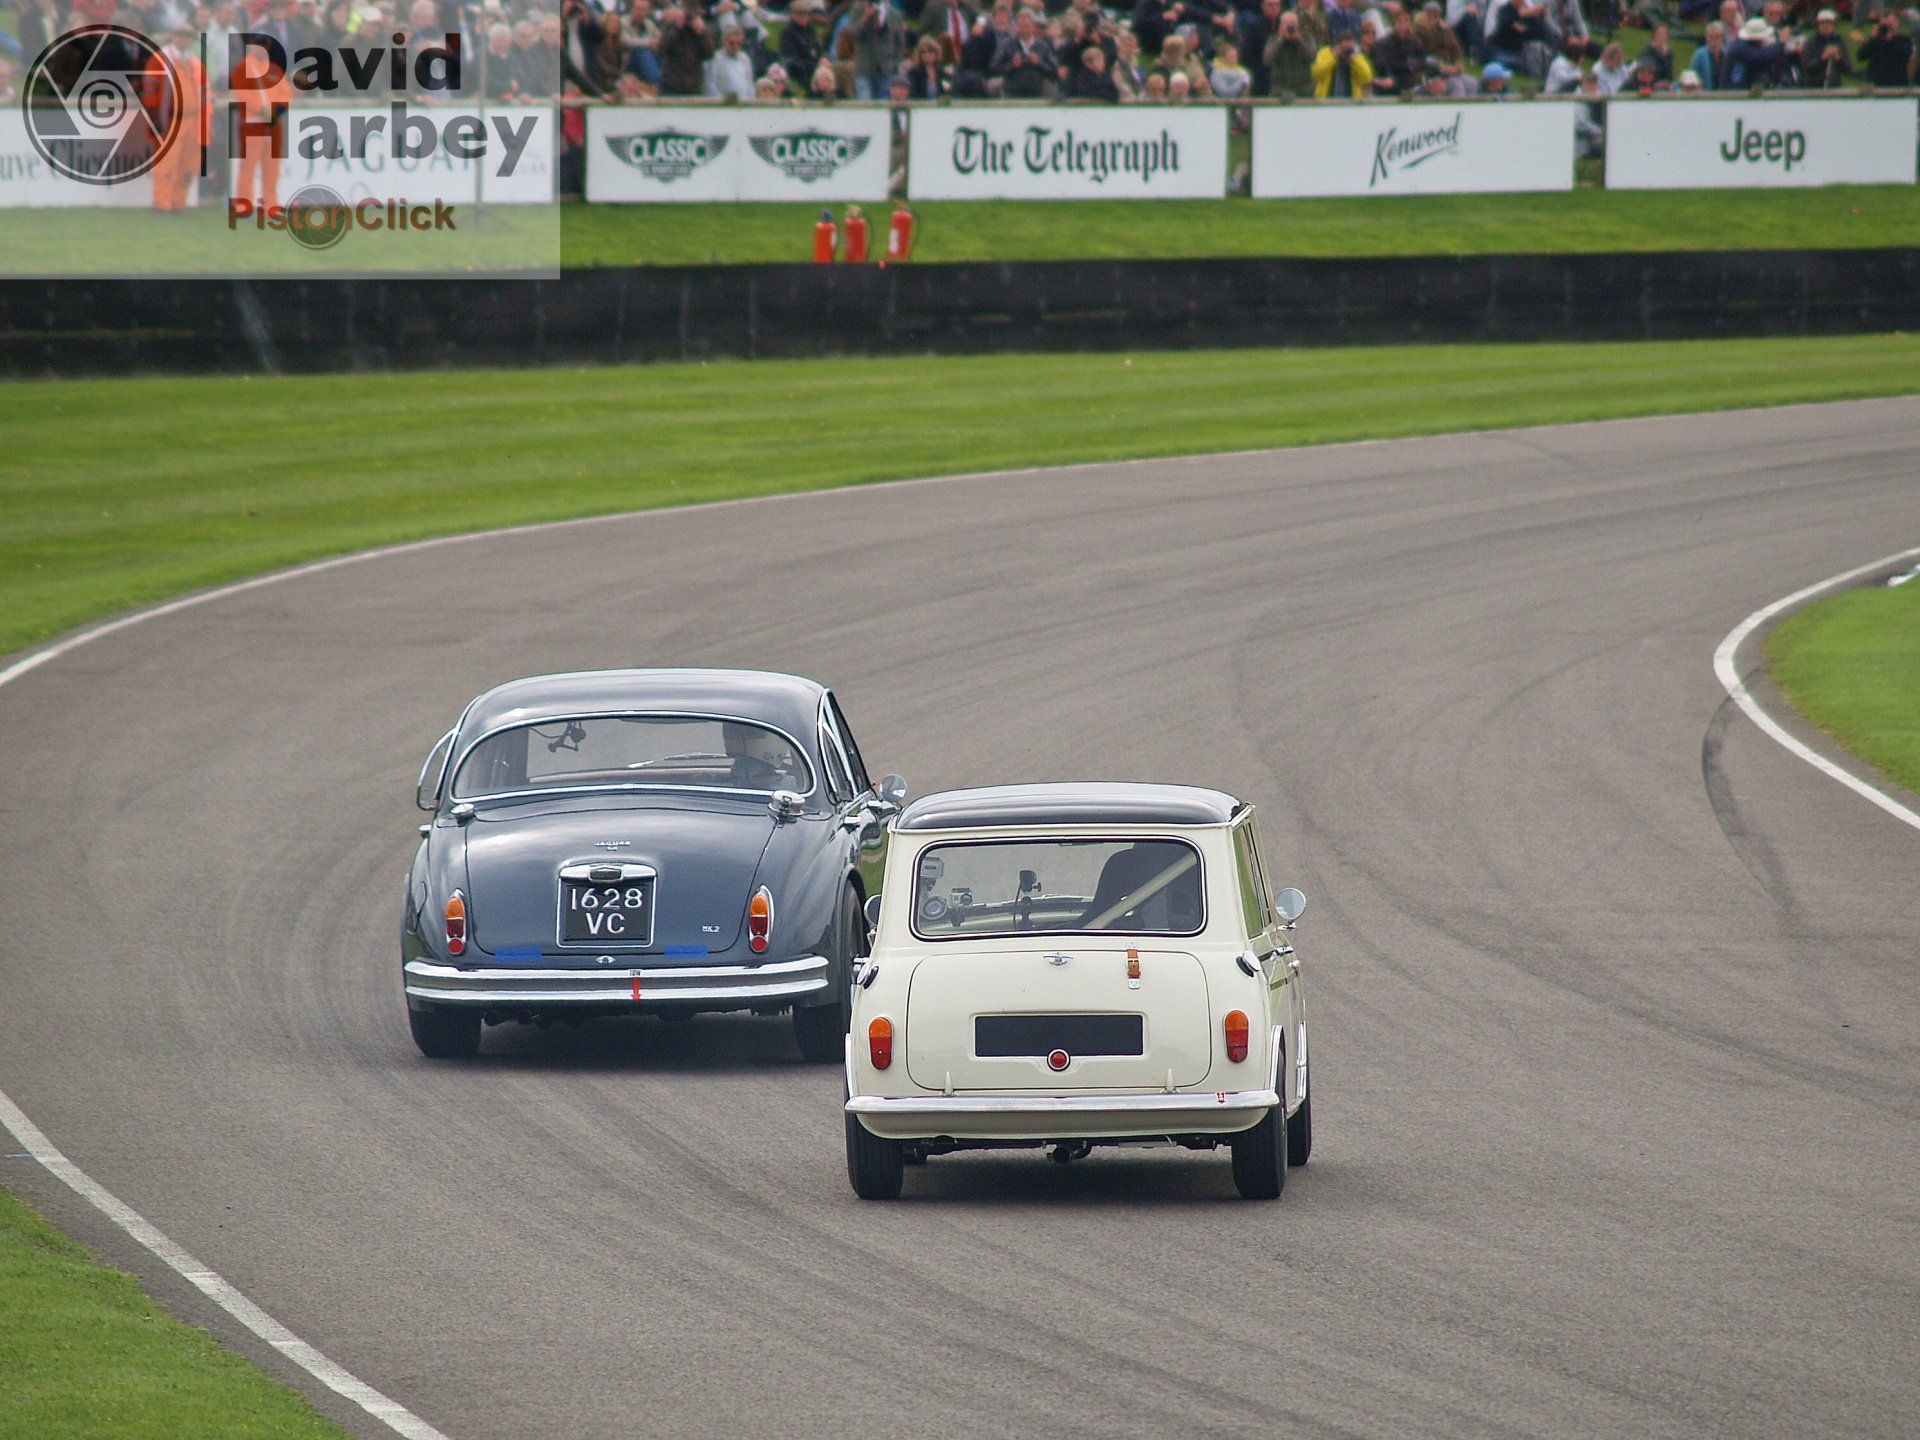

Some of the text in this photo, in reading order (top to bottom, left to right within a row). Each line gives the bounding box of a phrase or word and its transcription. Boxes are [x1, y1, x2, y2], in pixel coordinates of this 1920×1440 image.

[629, 137, 708, 165] CLASSIC
[772, 137, 849, 165] CLASSIC
[952, 125, 1179, 184] The Telegraph
[1369, 111, 1462, 187] Kenwood
[1720, 117, 1806, 172] Jeep
[571, 887, 643, 911] 1628
[585, 911, 626, 935] VC
